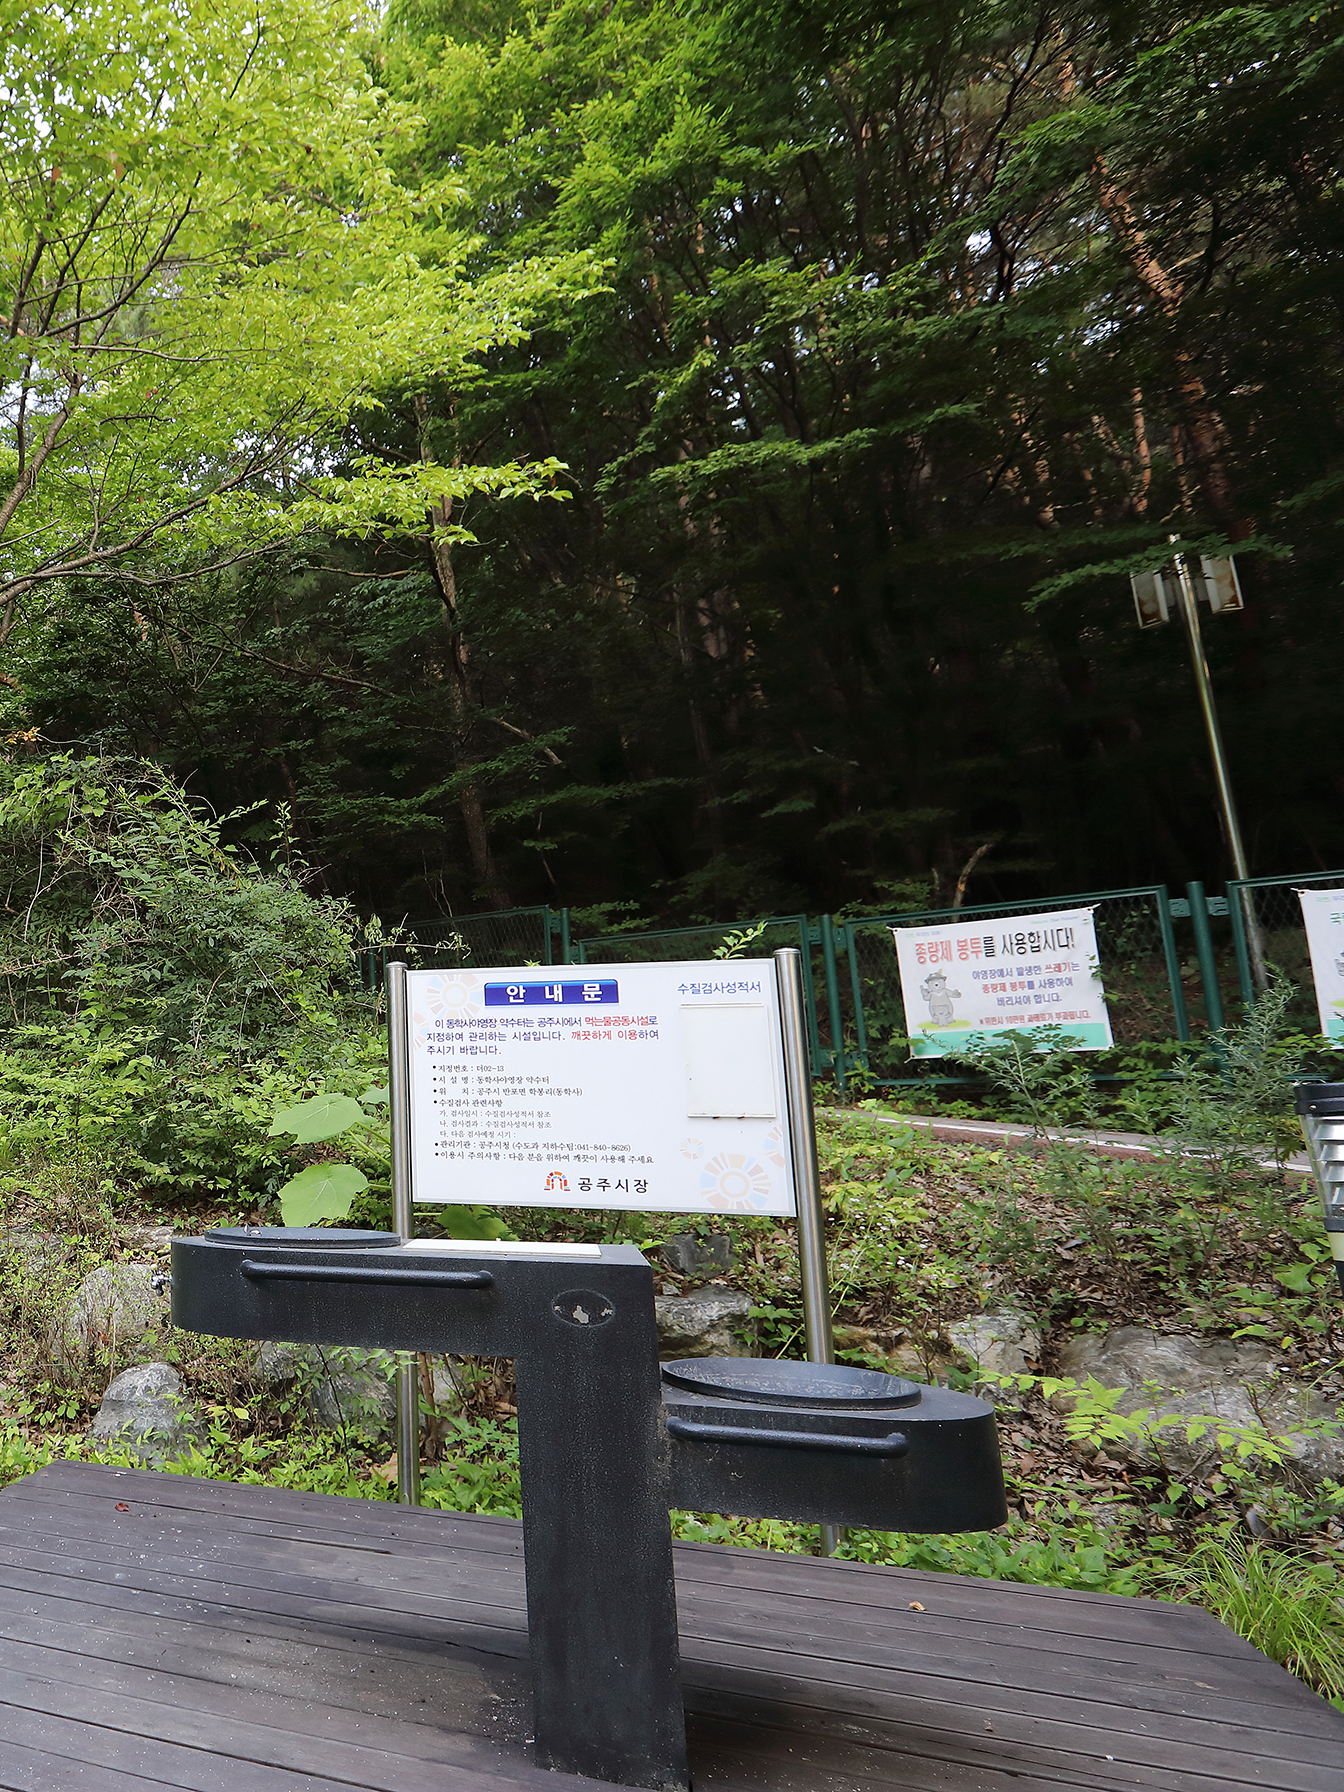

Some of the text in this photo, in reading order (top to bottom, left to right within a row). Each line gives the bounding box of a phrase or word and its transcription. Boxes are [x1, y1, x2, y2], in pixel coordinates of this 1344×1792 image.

[915, 927, 1075, 965] 종량제 봉투를 사용합시다!
[972, 967, 1013, 980] 야영장에서
[1045, 962, 1080, 974] 쓰레기는
[677, 981, 762, 995] 수질검사성적서
[982, 982, 1007, 994] 종량제
[1038, 976, 1073, 989] 사용하여
[1034, 992, 1062, 1005] 합니다.
[435, 1015, 658, 1029] 이 동학사야영장 약수터는 공주시에서 먹는물공동시설로
[427, 1029, 659, 1042] 지정하여 관리하는 시설입니다. 깨끗하게 이용하여
[427, 1045, 502, 1055] 주시기 바랍니다.
[438, 1064, 469, 1073] 지정번호
[477, 1076, 523, 1085] 동학사야영장
[526, 1076, 550, 1084] 약수터
[477, 1088, 500, 1096] 공주시
[503, 1087, 526, 1096] 반포면
[529, 1088, 583, 1096] 학봉리(동학사)
[439, 1099, 503, 1108] 수질검사 관련사항
[451, 1110, 478, 1118] 검사일시
[485, 1110, 534, 1118] 수질검사성적서
[451, 1120, 478, 1128] 검사결과
[485, 1120, 535, 1129] 수질검사성적서
[537, 1121, 552, 1129] 참조
[451, 1130, 465, 1138] 다음
[467, 1130, 495, 1139] 검사예정
[497, 1131, 511, 1139] 시기
[440, 1140, 471, 1149] 관리기관
[479, 1141, 510, 1150] 공주시청
[512, 1141, 539, 1150] (수도과
[440, 1151, 465, 1159] 이용시
[468, 1151, 501, 1160] 주의사항
[509, 1152, 525, 1161] 다음
[527, 1153, 543, 1162] 분을
[546, 1153, 570, 1162] 위하여
[573, 1154, 597, 1163] 깨끗이
[600, 1154, 626, 1163] 사용해
[628, 1155, 654, 1164] 주세요
[578, 1177, 648, 1193] 공주시장
